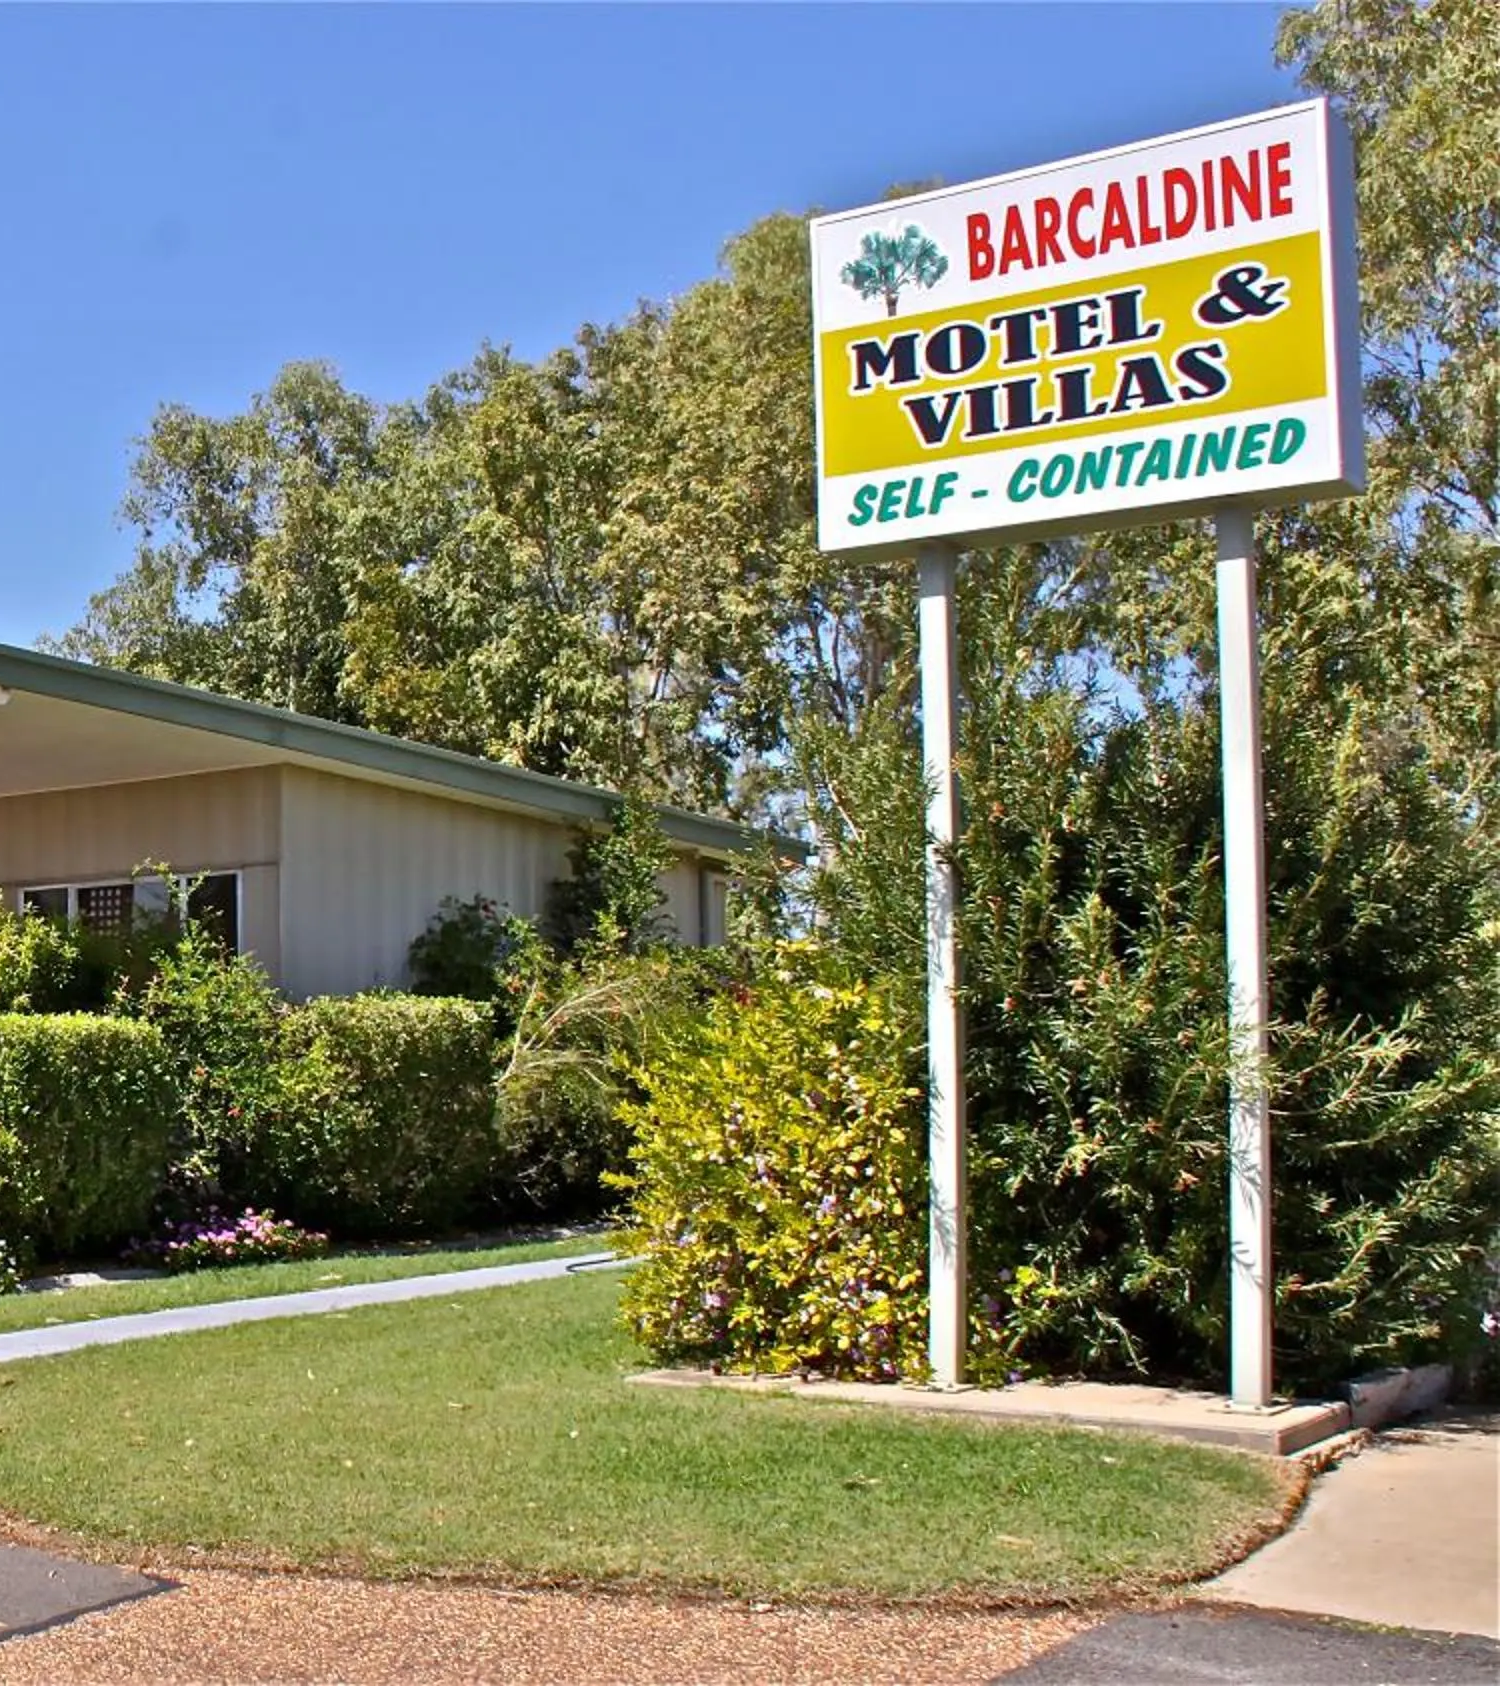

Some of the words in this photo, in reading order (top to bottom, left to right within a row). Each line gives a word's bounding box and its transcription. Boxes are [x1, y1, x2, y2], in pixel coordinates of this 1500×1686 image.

[967, 142, 1293, 281] BARCALDINE
[851, 289, 1160, 390] MOTEL
[1198, 266, 1286, 324] &
[904, 343, 1227, 444] VILLAS
[848, 472, 959, 527] SELF
[1007, 418, 1307, 503] CONTAINED
